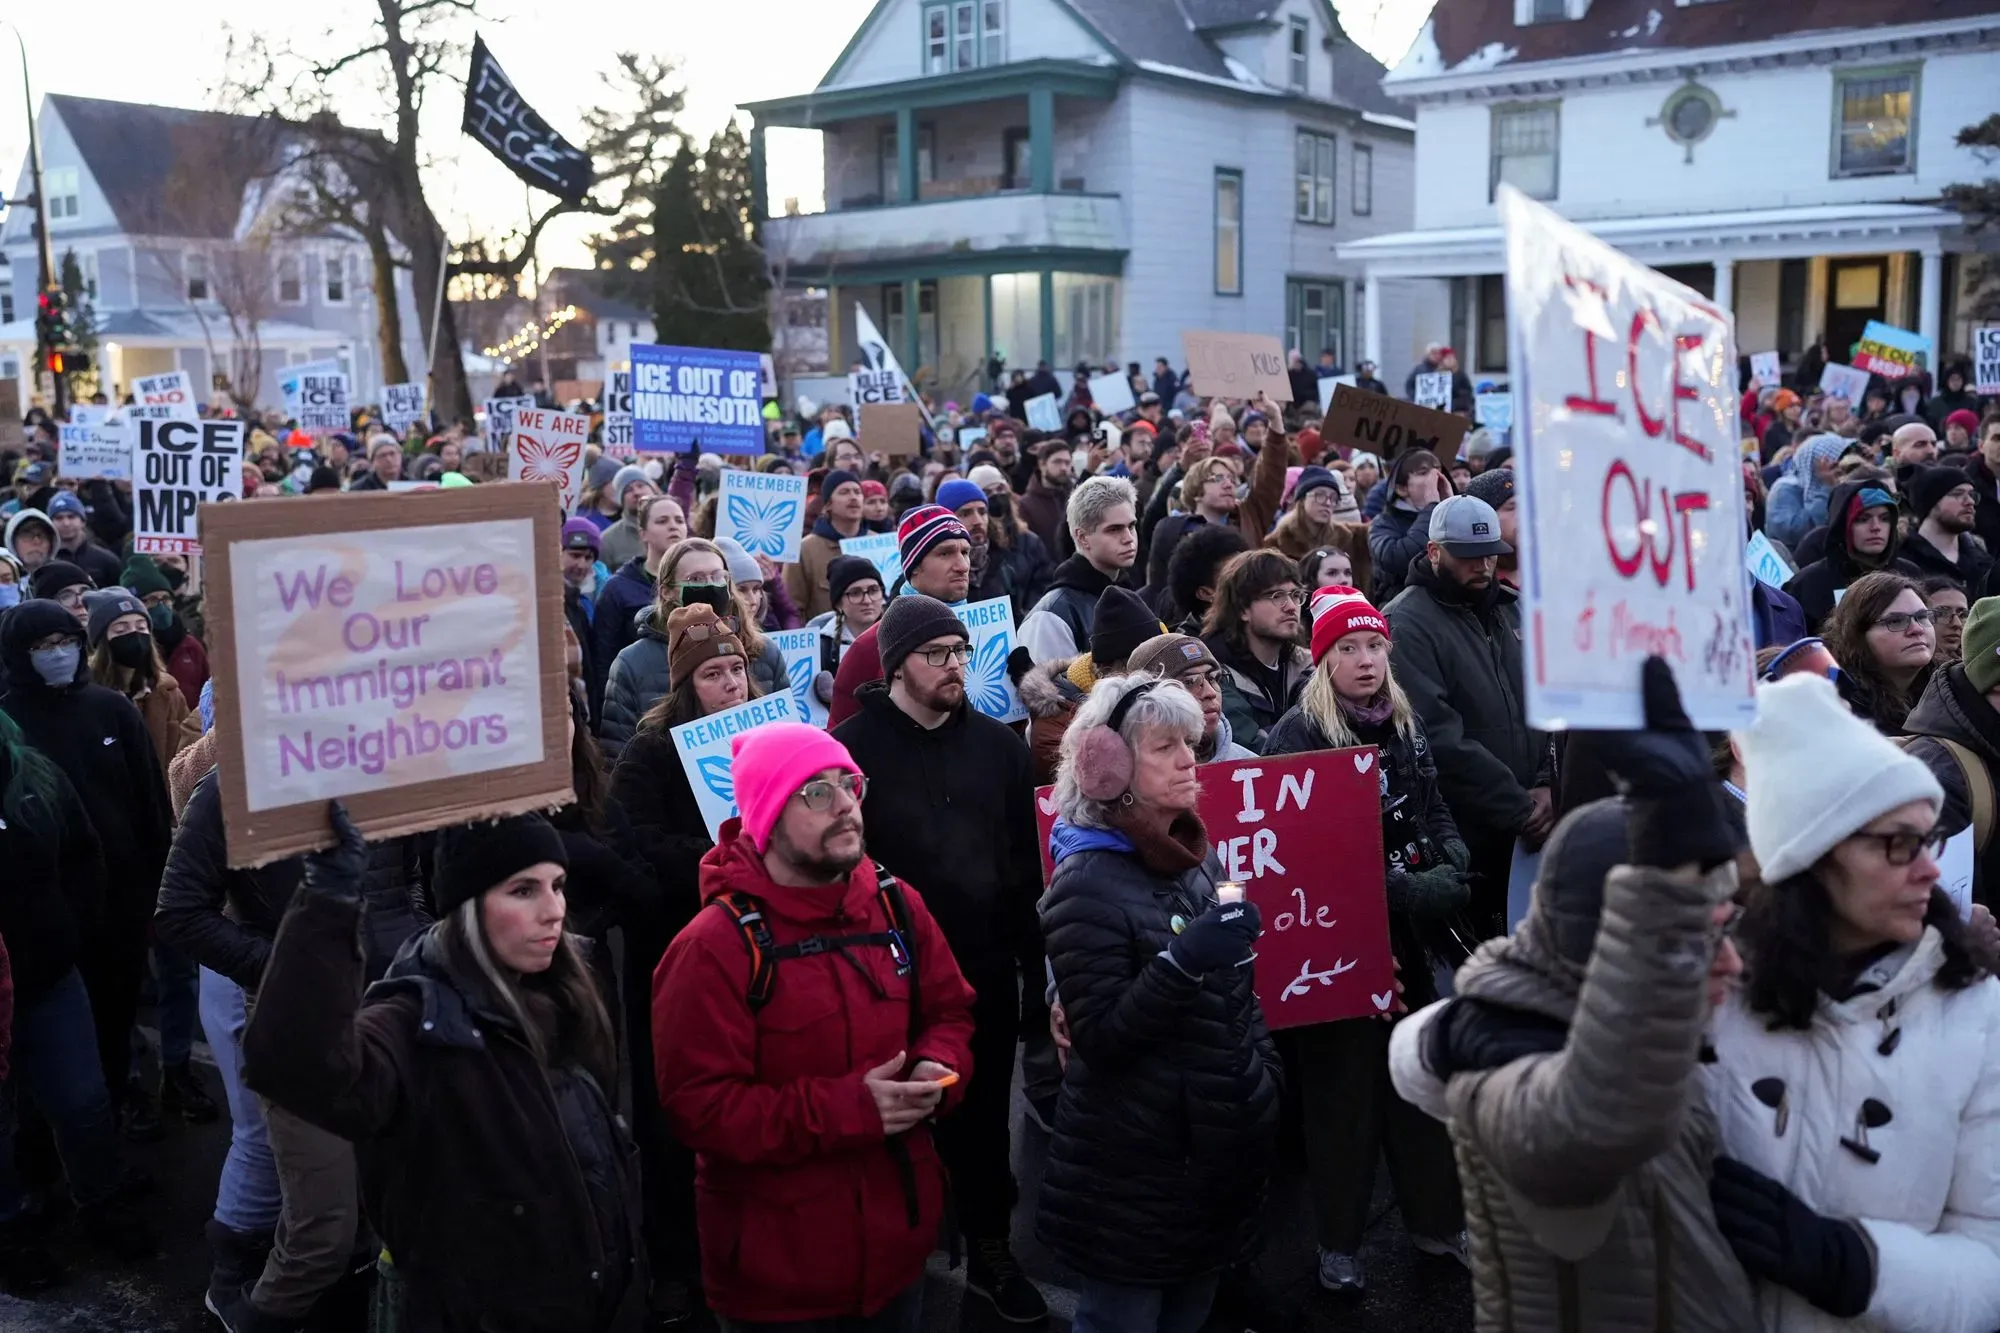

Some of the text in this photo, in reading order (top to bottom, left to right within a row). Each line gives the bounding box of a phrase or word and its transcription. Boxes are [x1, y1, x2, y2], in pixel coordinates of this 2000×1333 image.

[1980, 331, 2000, 346] IC
[636, 363, 672, 392] ICE
[678, 366, 723, 396] OUT
[729, 370, 757, 398] OF
[1563, 272, 1713, 464] ICE
[144, 391, 185, 404] NO
[301, 390, 345, 406] ICE
[608, 394, 631, 413] IC
[634, 392, 761, 426] MINNESOTA
[855, 386, 900, 404] ICE
[63, 428, 88, 442] ICE
[140, 420, 238, 454] ICE
[519, 411, 545, 430] WE
[551, 416, 585, 436] ARE
[145, 453, 230, 487] OUT OF
[727, 474, 801, 493] REMEMBER
[1602, 458, 1710, 593] OUT
[844, 534, 897, 552] REMEMBE
[274, 560, 498, 613] We Love
[957, 602, 1008, 628] EMBER
[342, 612, 430, 653] Our
[772, 632, 815, 650] MBER
[275, 648, 507, 714] Immigrant
[683, 697, 790, 750] REMEMBER
[278, 713, 508, 777] Neighbors
[1230, 767, 1315, 824] IN
[1221, 908, 1245, 922] swix
[1273, 887, 1337, 931] ole
